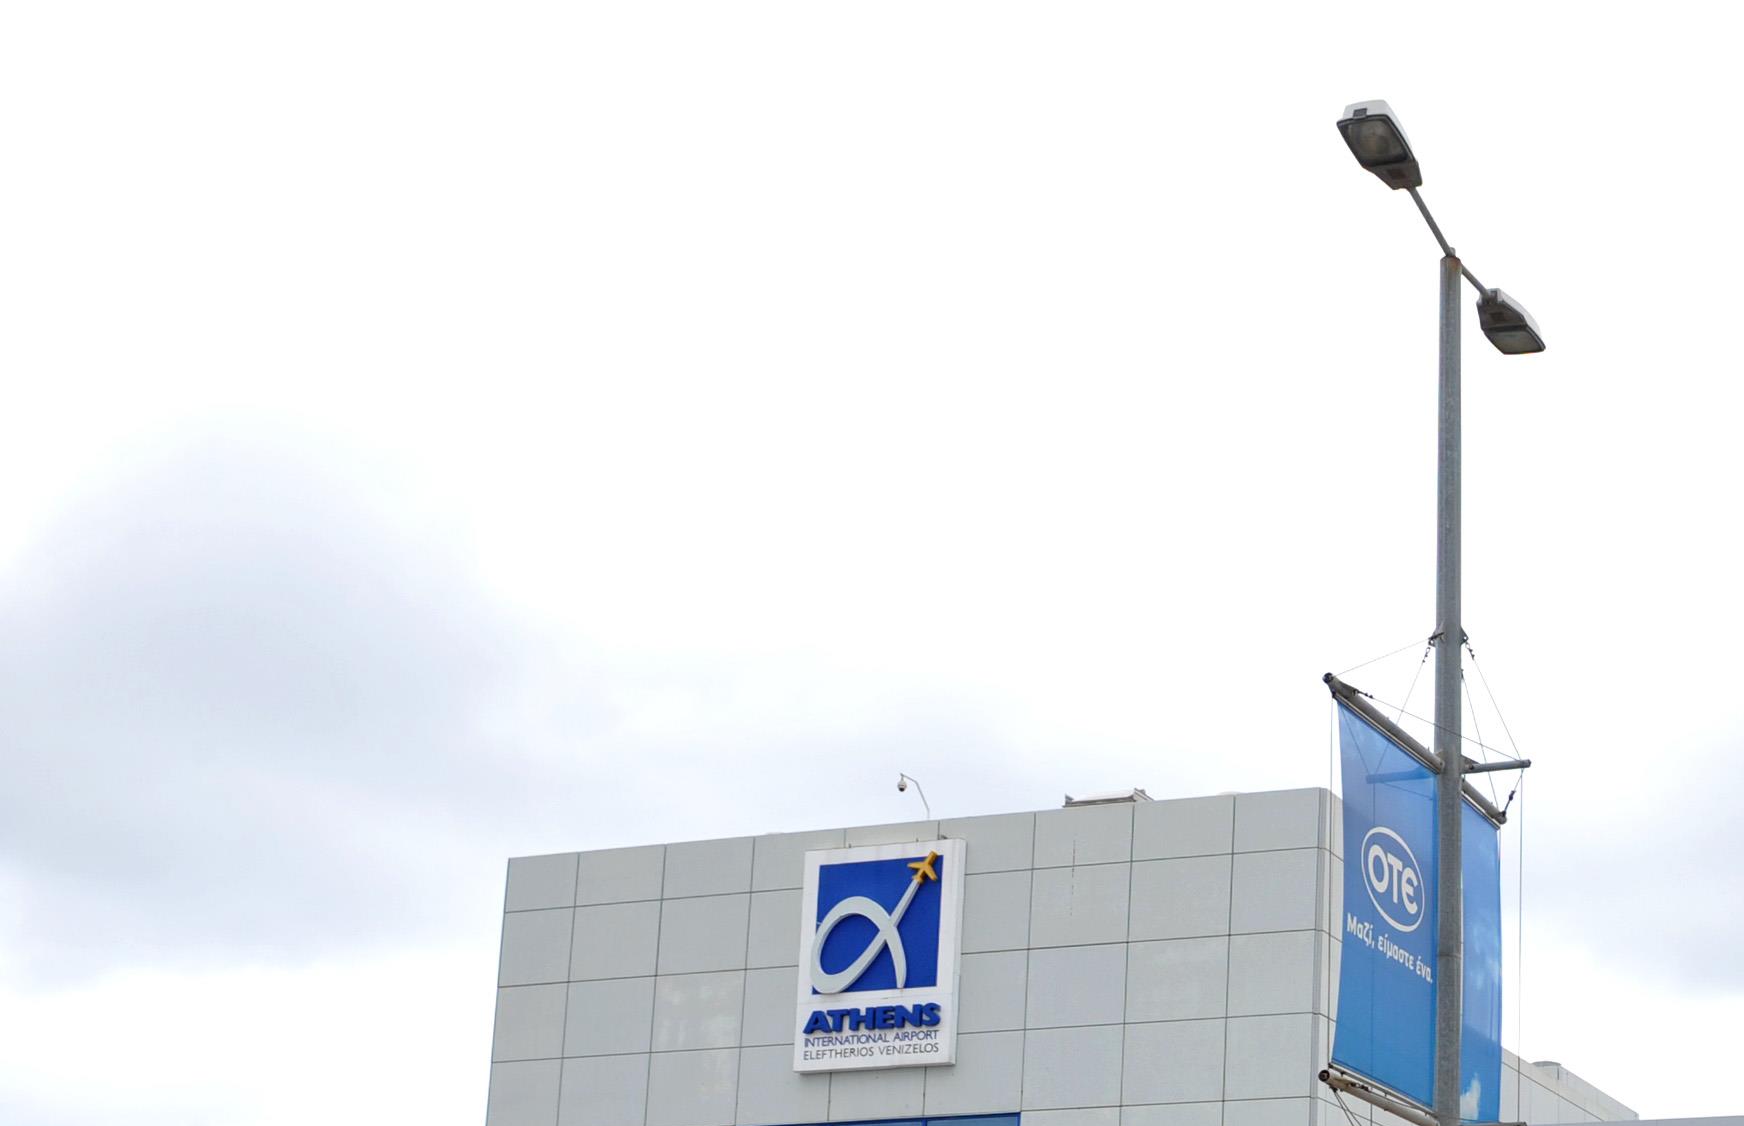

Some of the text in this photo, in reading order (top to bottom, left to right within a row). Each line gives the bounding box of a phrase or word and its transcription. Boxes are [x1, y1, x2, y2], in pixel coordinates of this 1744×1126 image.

[1378, 934, 1414, 970] είμαστε
[803, 1003, 941, 1034] ATHENS
[804, 1030, 938, 1048] INTERNATIONAL AIRPORT
[804, 1042, 939, 1060] ELEFTHERIOS VENIZELOS
